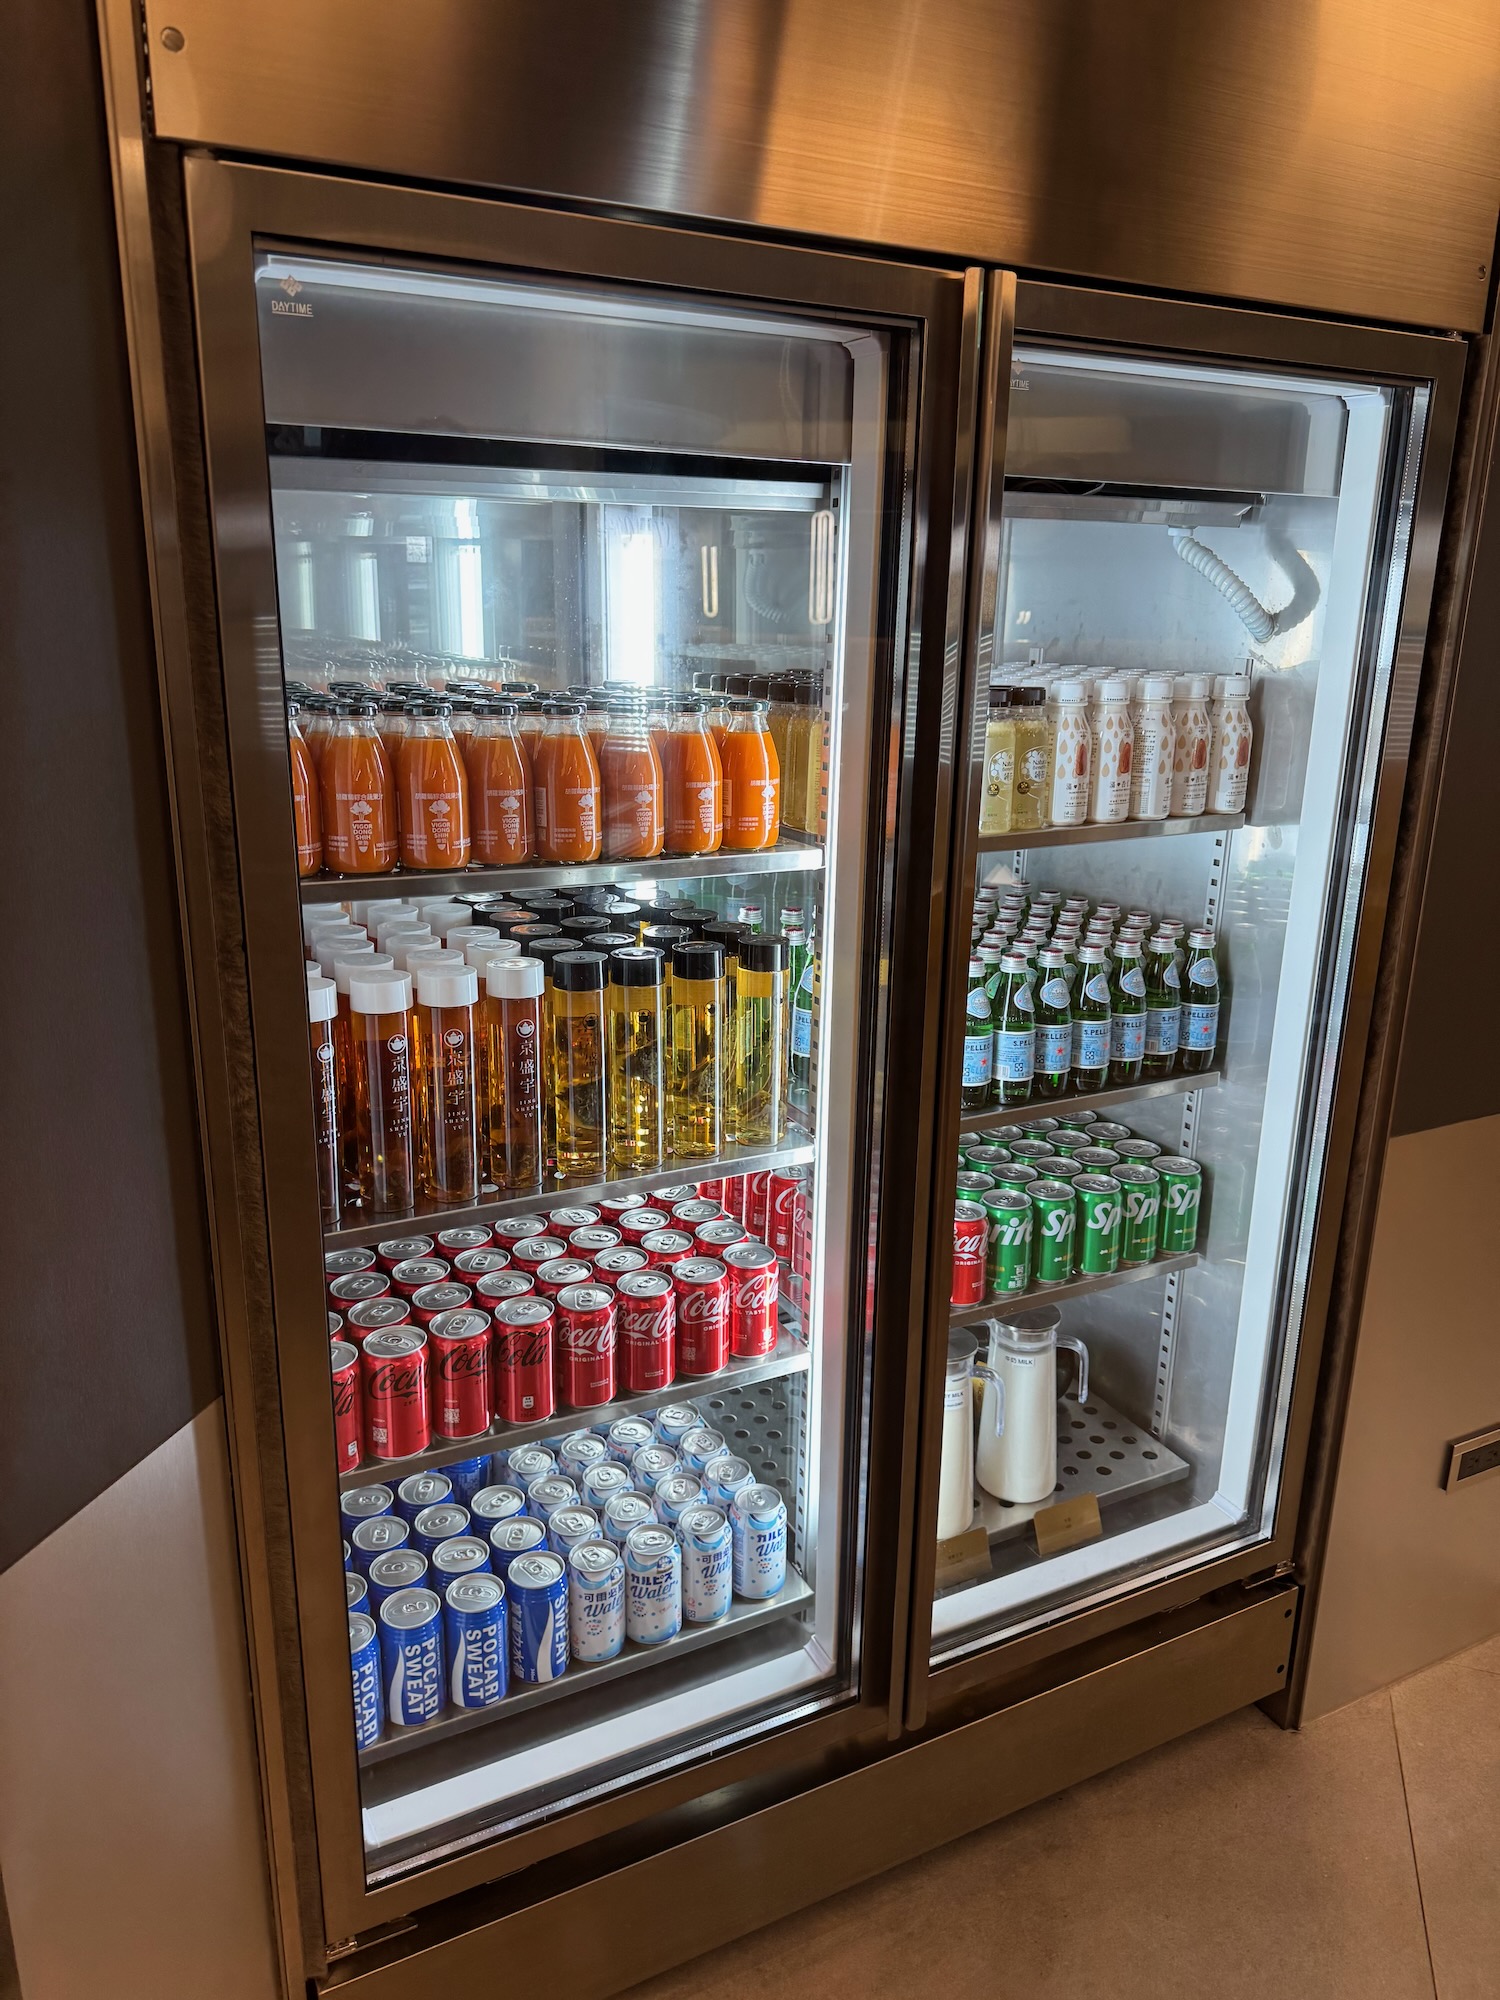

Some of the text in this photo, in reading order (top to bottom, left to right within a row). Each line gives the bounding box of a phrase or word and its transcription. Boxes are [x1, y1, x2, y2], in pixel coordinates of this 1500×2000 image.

[271, 300, 313, 315] DAYTIME
[391, 1055, 408, 1112] 京盛宇
[447, 1050, 465, 1106] 京盛宇
[519, 1039, 536, 1094] 京盛宇
[444, 1116, 470, 1124] SHENG
[447, 1110, 466, 1118] JING
[568, 1354, 605, 1362] ORIGINAL
[1018, 1358, 1034, 1366] MILK
[630, 1570, 673, 1586] カルピス
[630, 1580, 677, 1600] Water
[554, 1595, 567, 1665] SWEAT
[404, 1643, 425, 1715] SWEAT
[421, 1636, 440, 1720] POCARI
[465, 1629, 485, 1700] SWEAT
[482, 1623, 500, 1705] POCARI
[359, 1660, 379, 1746] POCARI
